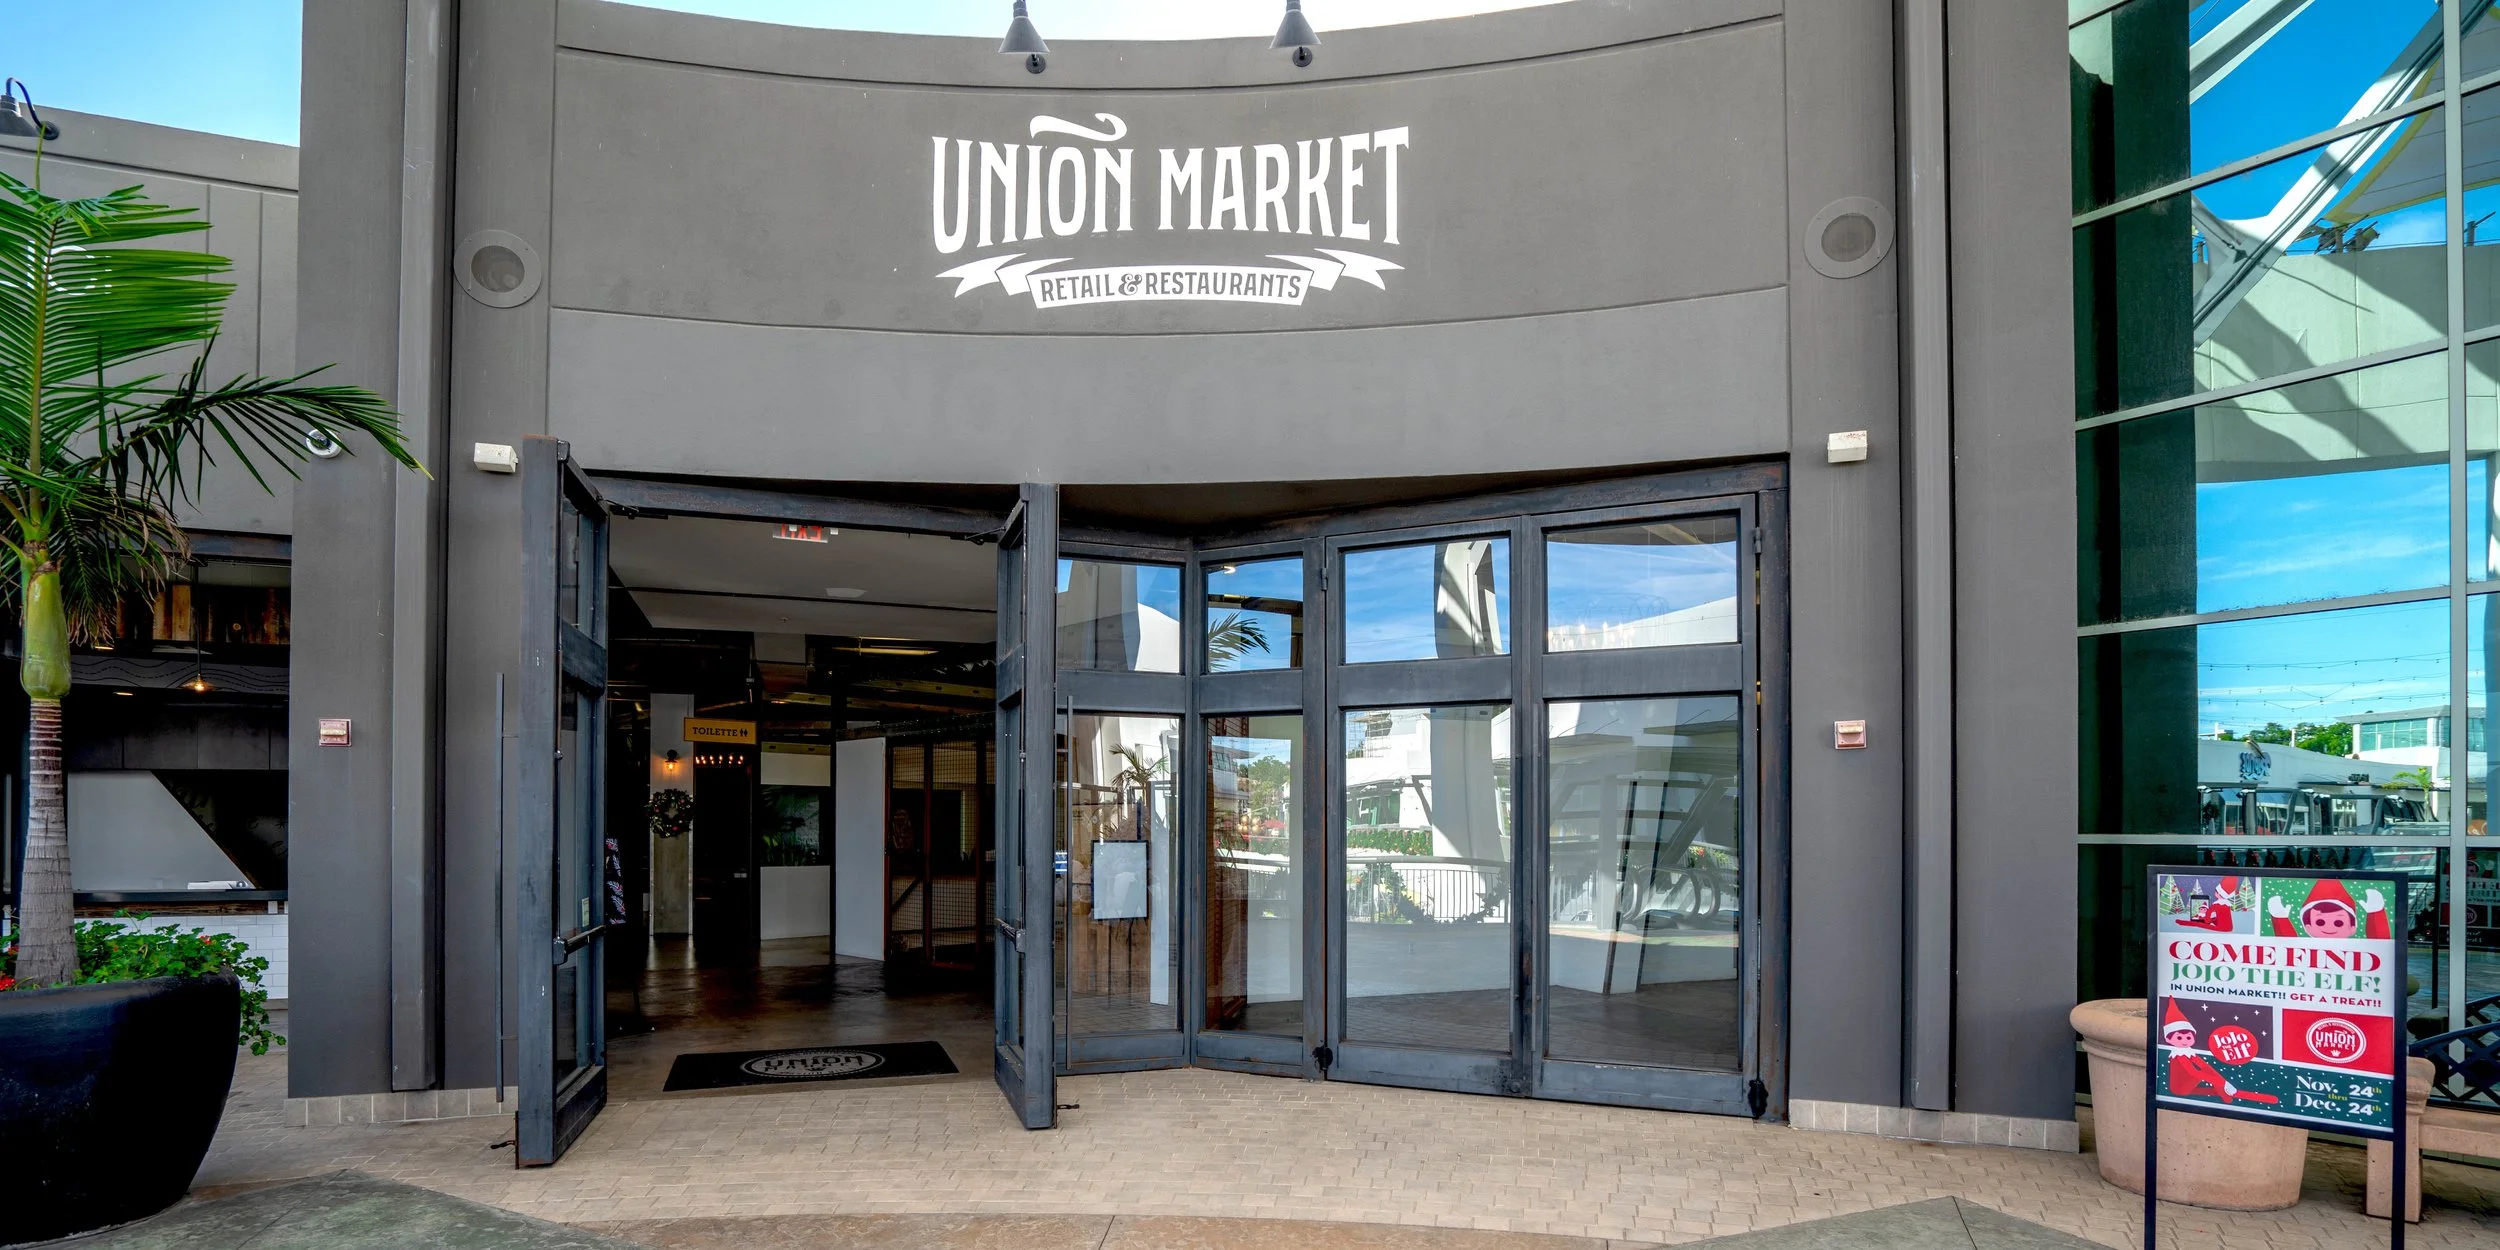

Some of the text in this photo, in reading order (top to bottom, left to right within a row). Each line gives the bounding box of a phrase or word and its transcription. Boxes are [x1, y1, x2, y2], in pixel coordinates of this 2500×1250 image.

[932, 126, 1409, 254] UNION MARKET
[1040, 271, 1301, 302] RETAIL & RESTAURANTS
[692, 726, 738, 737] TOILETTE
[2169, 940, 2381, 972] COME FIND
[2172, 962, 2381, 994] JOJO THE ELF!
[2170, 983, 2381, 1008] IN UNION MARKET!! GET A TREAT!!
[2316, 1030, 2356, 1045] UNION
[2222, 1042, 2251, 1061] Elf
[2296, 1075, 2382, 1098] Nov. 24th
[2295, 1093, 2382, 1116] Dec. 24th
